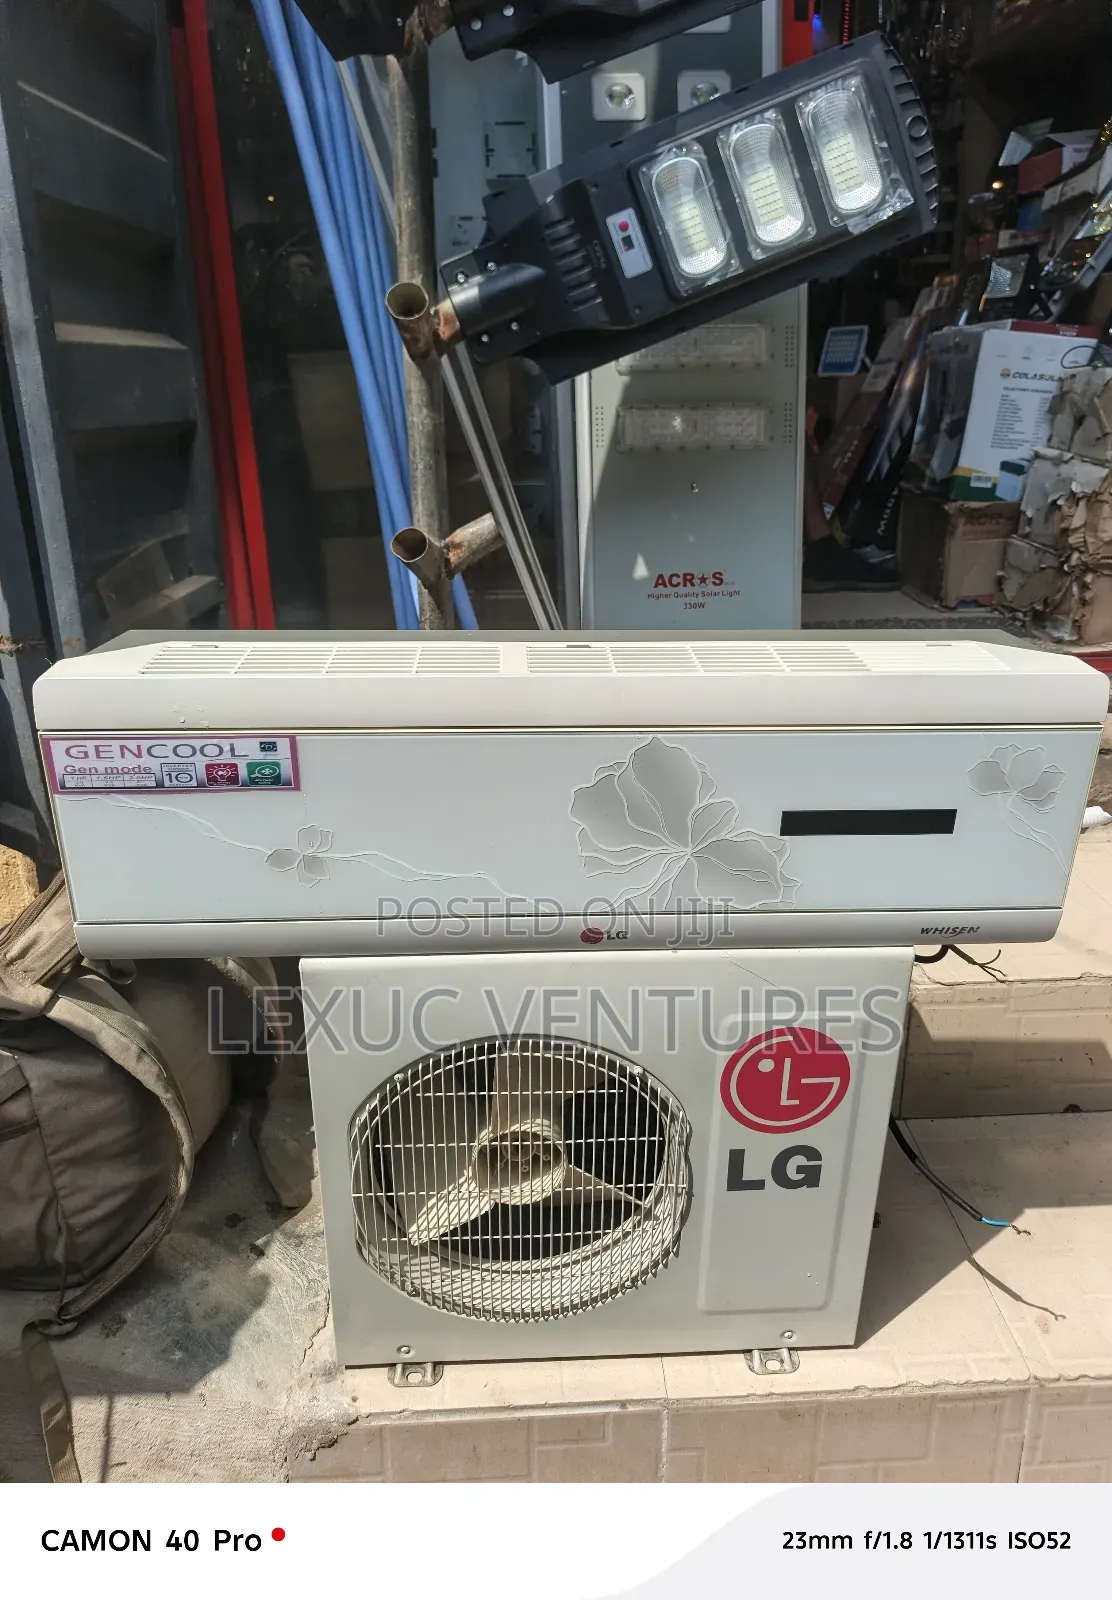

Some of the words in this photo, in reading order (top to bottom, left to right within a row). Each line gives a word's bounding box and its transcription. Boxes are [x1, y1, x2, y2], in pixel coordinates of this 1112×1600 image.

[673, 591, 700, 599] Quality
[683, 602, 706, 610] 330W
[64, 742, 250, 760] GENCOOL
[63, 764, 99, 774] Gen
[104, 764, 153, 774] mode
[606, 930, 628, 941] LG
[920, 926, 981, 936] WHISEN
[726, 1144, 823, 1192] LG
